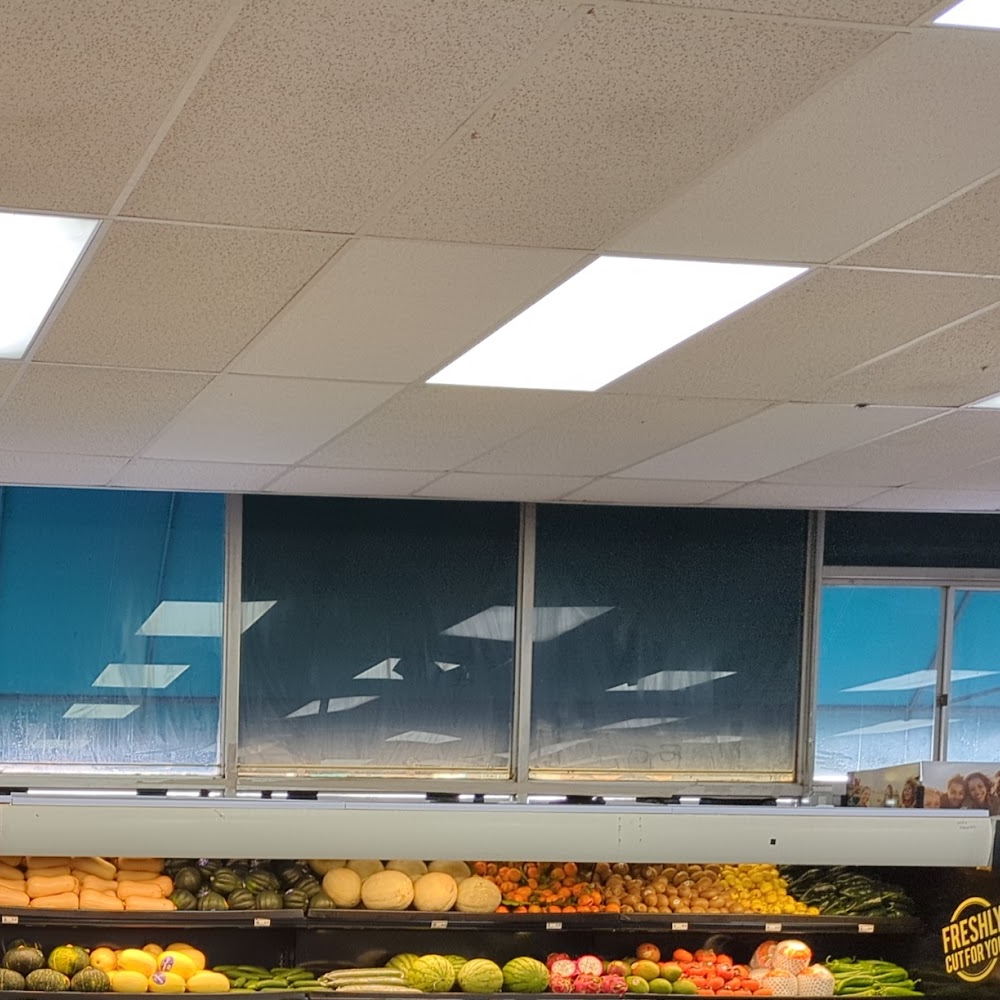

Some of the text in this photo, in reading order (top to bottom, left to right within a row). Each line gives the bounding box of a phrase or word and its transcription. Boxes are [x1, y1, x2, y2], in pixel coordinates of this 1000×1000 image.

[945, 935, 1000, 974] CUT FOR YO
